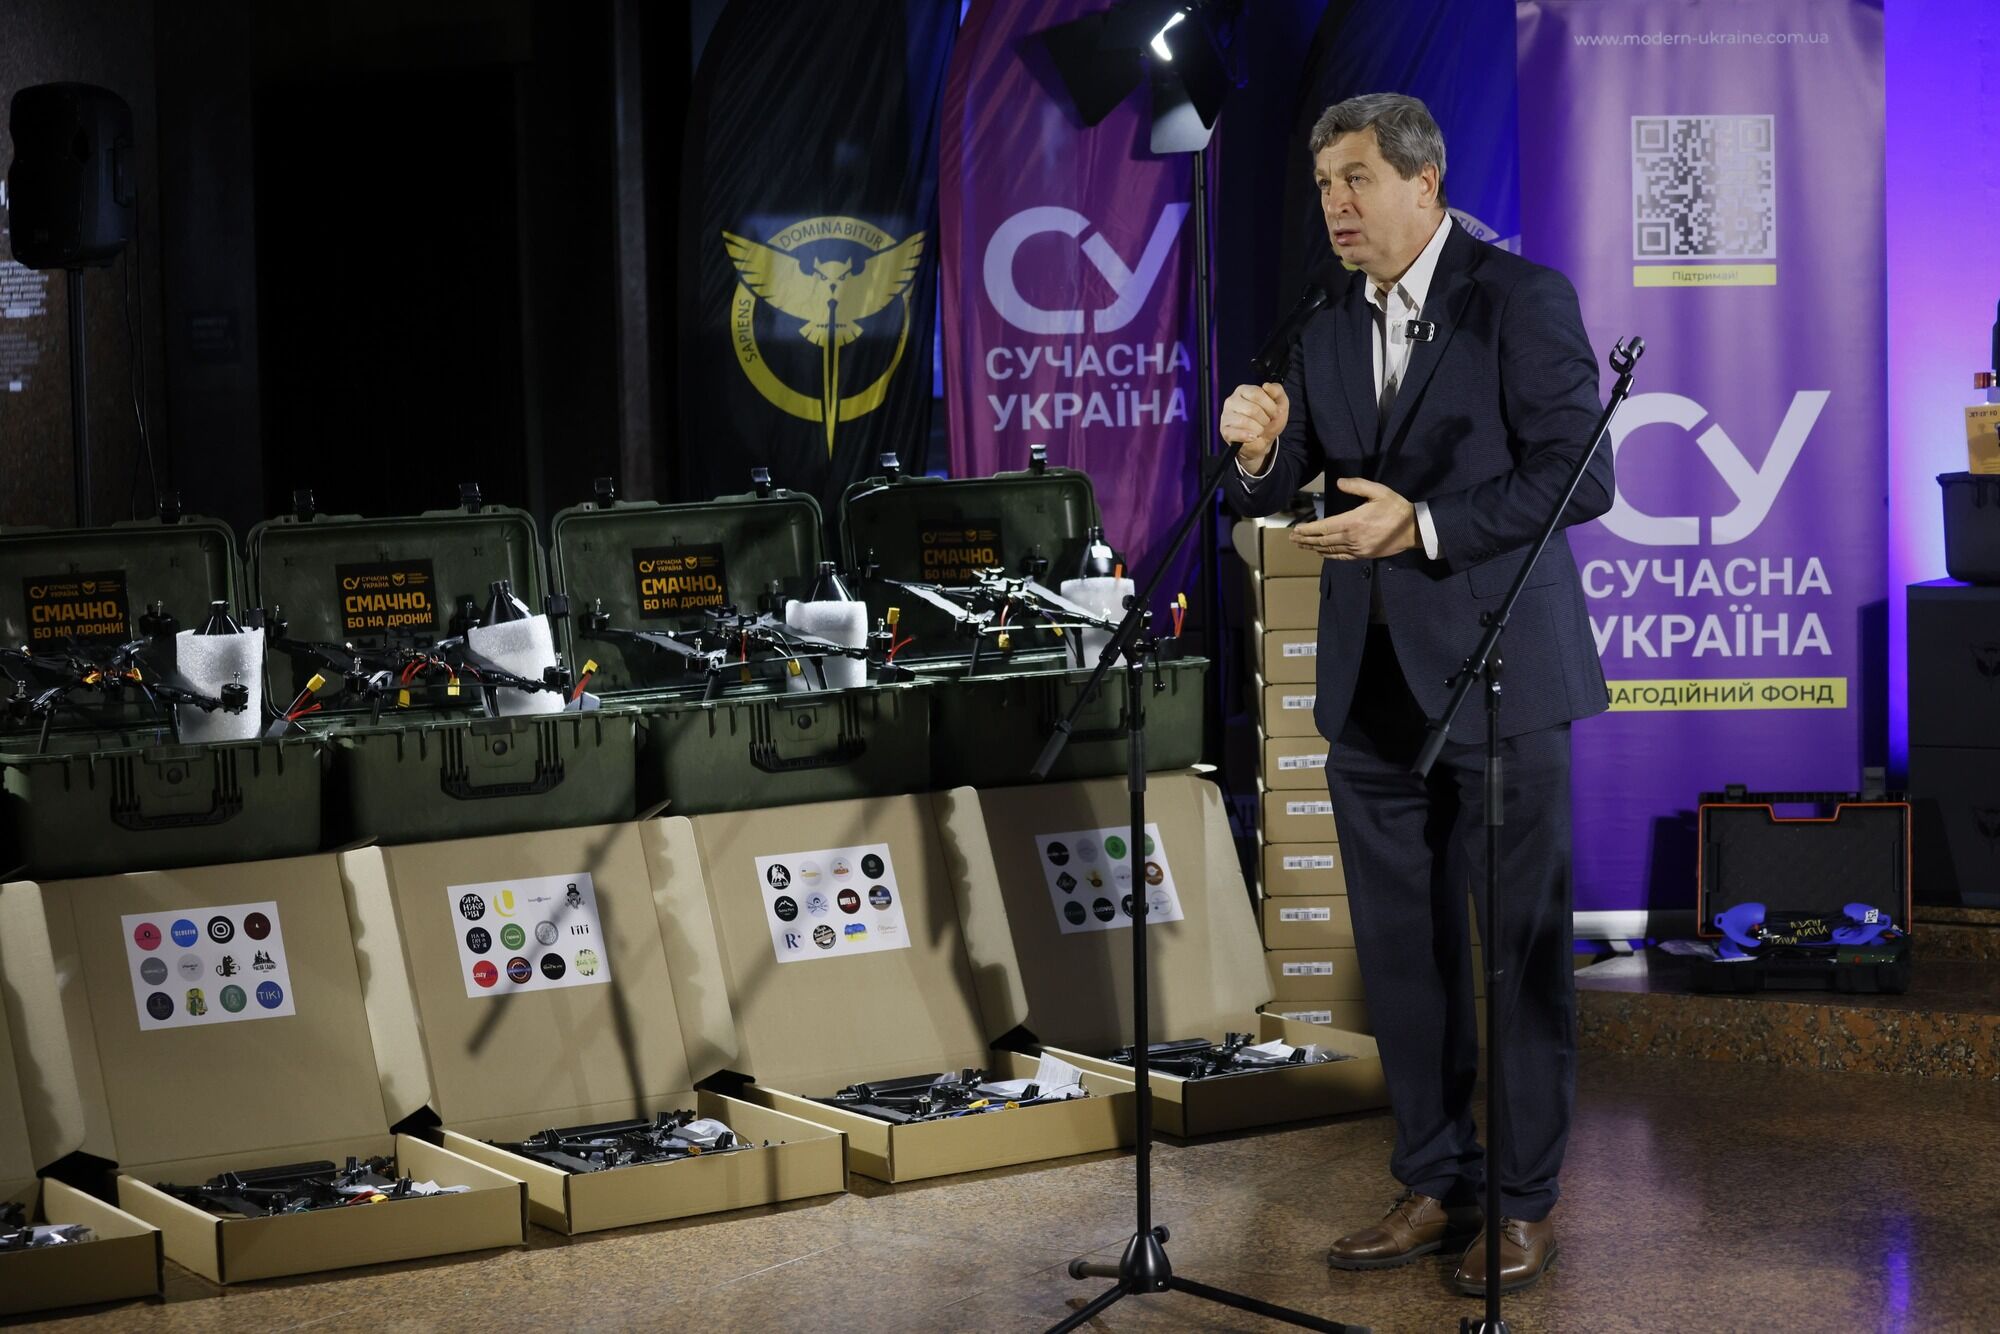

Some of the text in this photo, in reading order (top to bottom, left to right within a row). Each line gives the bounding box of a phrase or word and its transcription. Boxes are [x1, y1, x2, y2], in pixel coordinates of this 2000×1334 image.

[1574, 30, 1829, 47] www.modern-ukraine.com.ua
[779, 221, 883, 249] DOMINABITUR
[983, 202, 1192, 335] СУ
[1672, 271, 1738, 282] Підтримай!
[737, 298, 758, 363] SAPIENS
[986, 341, 1191, 381] СУЧАСНА
[987, 383, 1188, 432] УКРАЇНА
[923, 547, 999, 566] СМАЧНО,
[641, 575, 722, 596] СМАЧНО,
[1582, 557, 1833, 599] СУЧАСНА
[32, 600, 124, 622] СМАЧНО,
[345, 591, 431, 613] СМАЧНО,
[643, 594, 724, 610] БО НА ДРОНИ!
[33, 626, 51, 640] БО
[54, 624, 72, 637] НА
[347, 613, 433, 629] БО НА ДРОНИ!
[1589, 604, 1833, 658] УКРАЇНА
[1606, 683, 1834, 705] АГОДІЙНИЙ ФОНД
[257, 990, 281, 1001] TIKI
